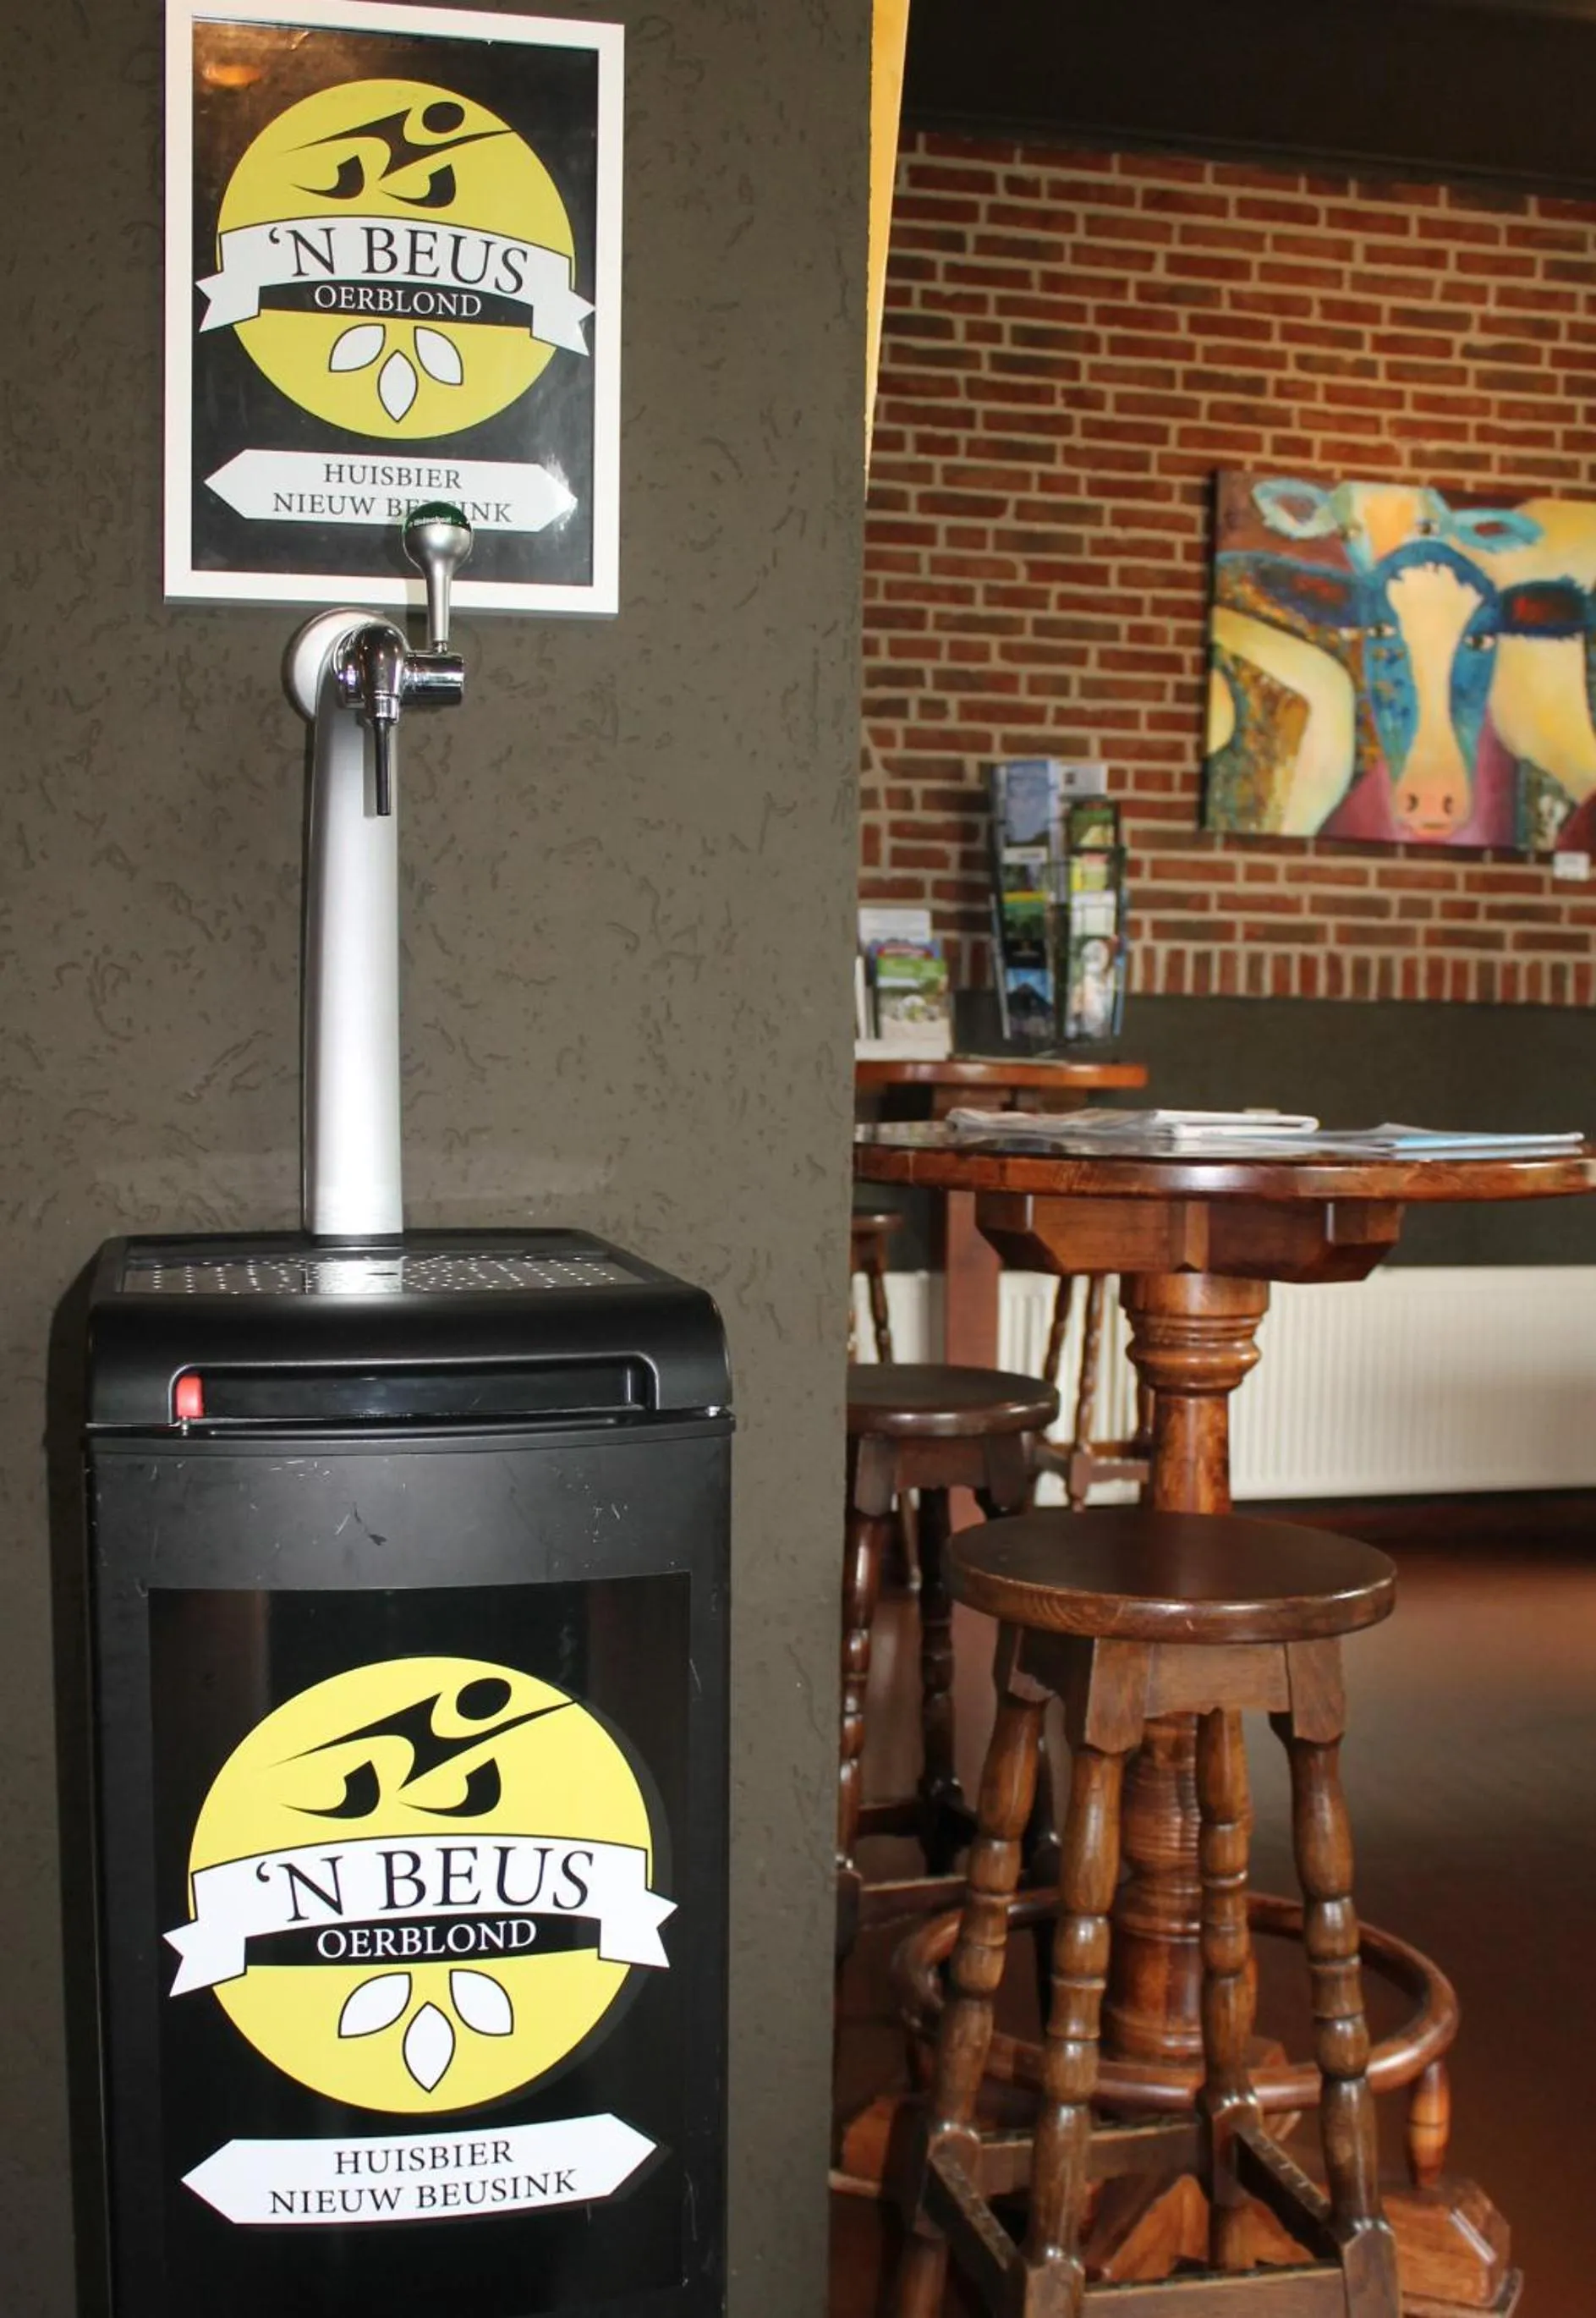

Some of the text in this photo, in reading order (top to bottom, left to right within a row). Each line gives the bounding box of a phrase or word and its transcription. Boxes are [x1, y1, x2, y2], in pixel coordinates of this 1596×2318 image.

[361, 227, 529, 294] BEUS
[314, 285, 482, 317] OERBLOND
[324, 464, 462, 489] HUISBIER
[273, 492, 377, 515] NIEUW
[387, 497, 512, 523] BEINK
[376, 1845, 594, 1910] BEUS
[317, 1919, 536, 1958] OERBLOND
[335, 2140, 513, 2174] HUISBIER
[270, 2169, 577, 2214] NIEUW BEUSINK
